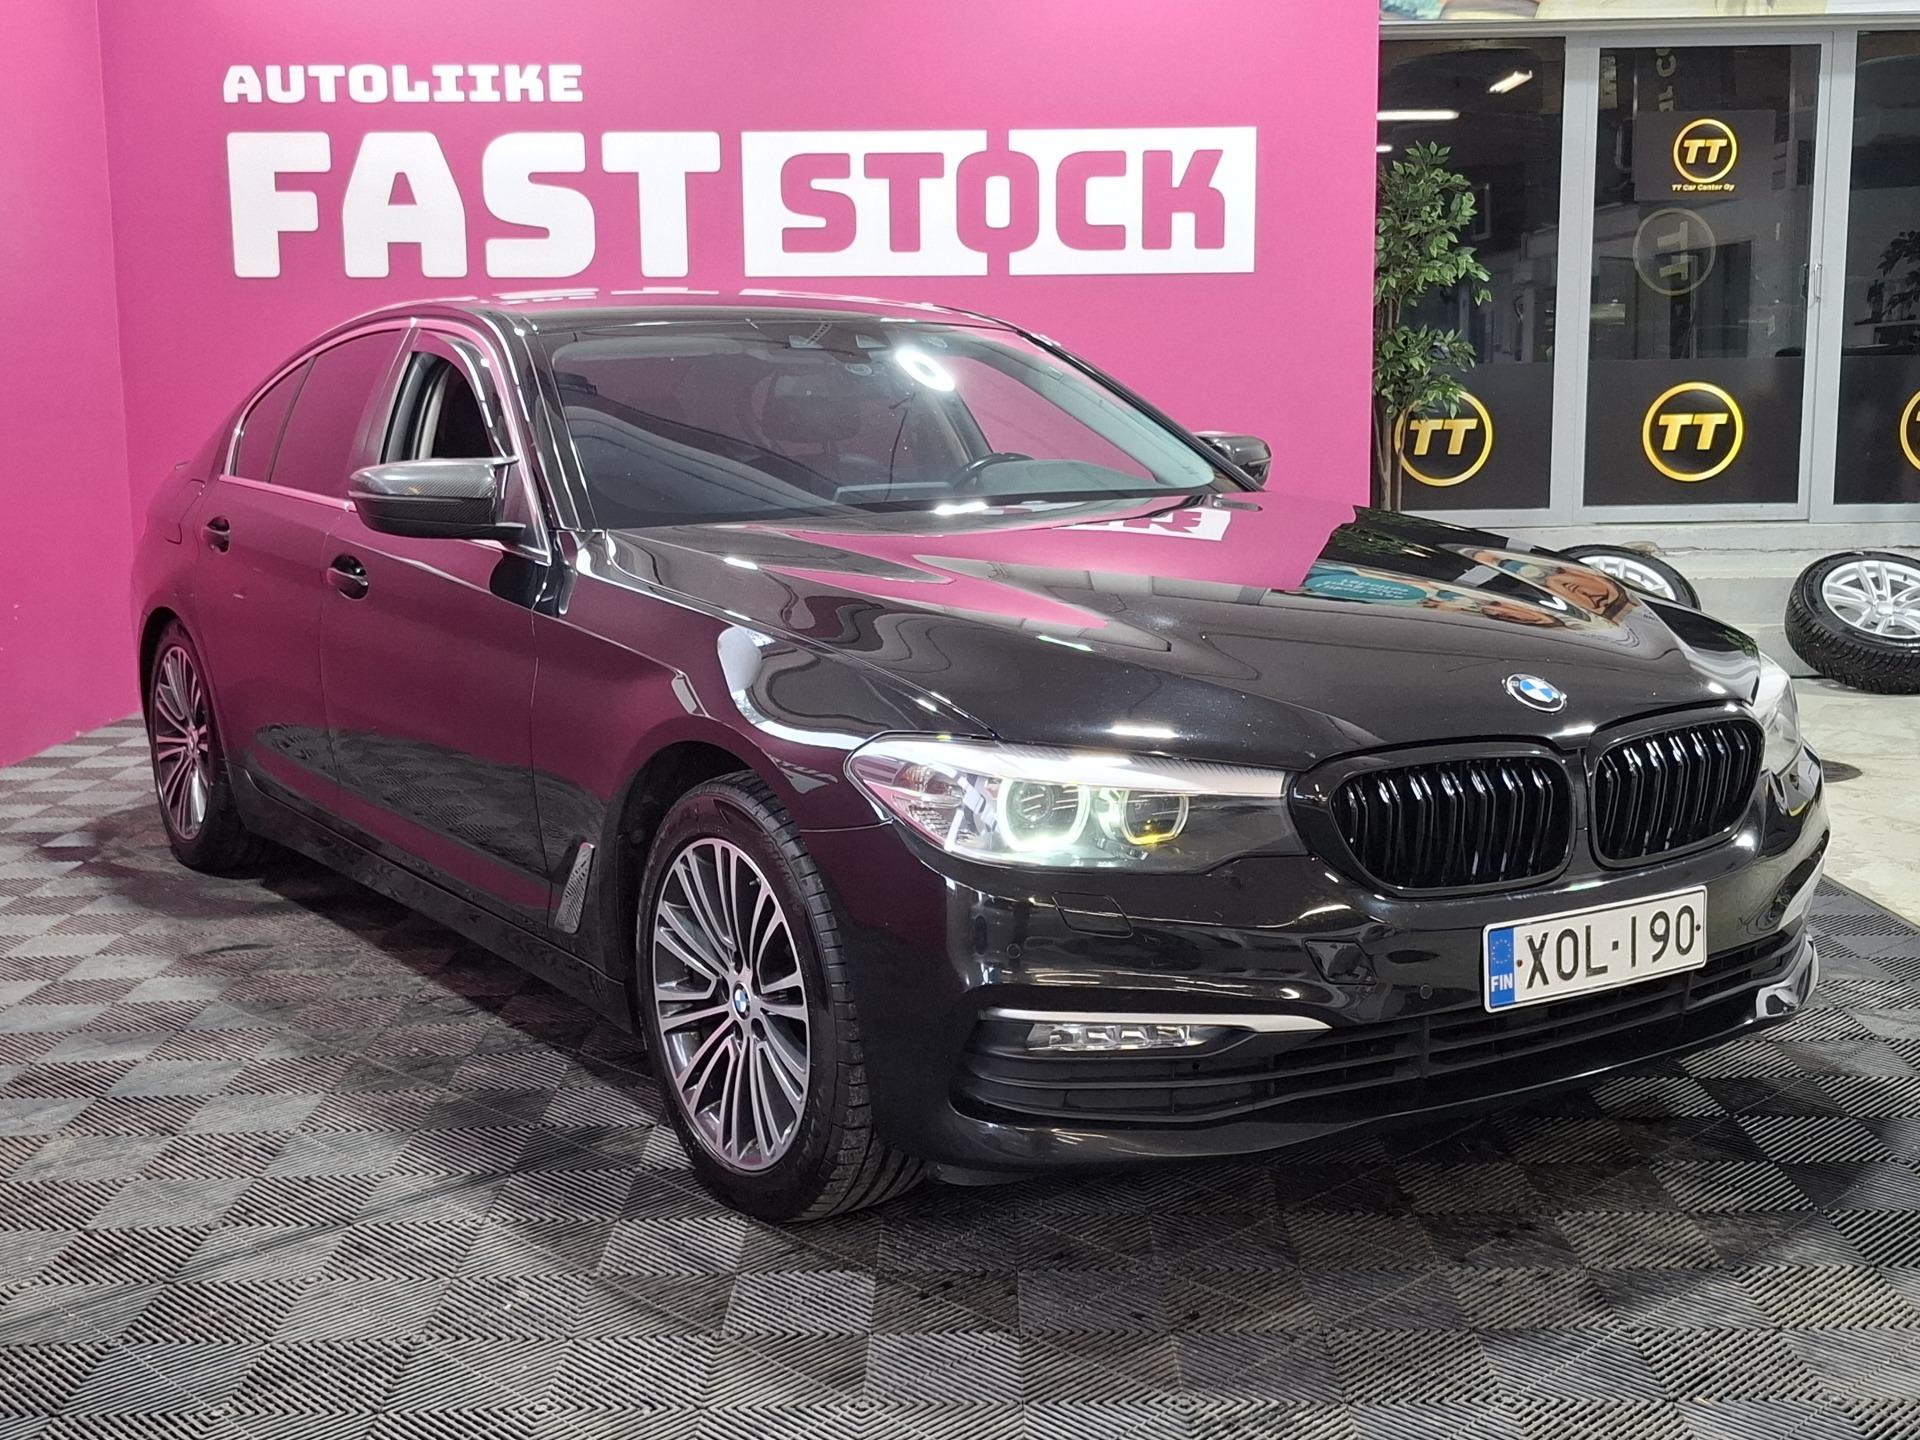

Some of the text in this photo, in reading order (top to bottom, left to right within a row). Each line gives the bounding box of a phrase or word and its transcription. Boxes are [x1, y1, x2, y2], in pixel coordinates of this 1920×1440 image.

[223, 64, 584, 103] AUTOLIIKE
[1683, 138, 1728, 164] TT
[226, 132, 1226, 278] FAST STOCK
[1409, 418, 1478, 455] TT
[1658, 413, 1729, 451] TT
[1490, 972, 1513, 993] FIN
